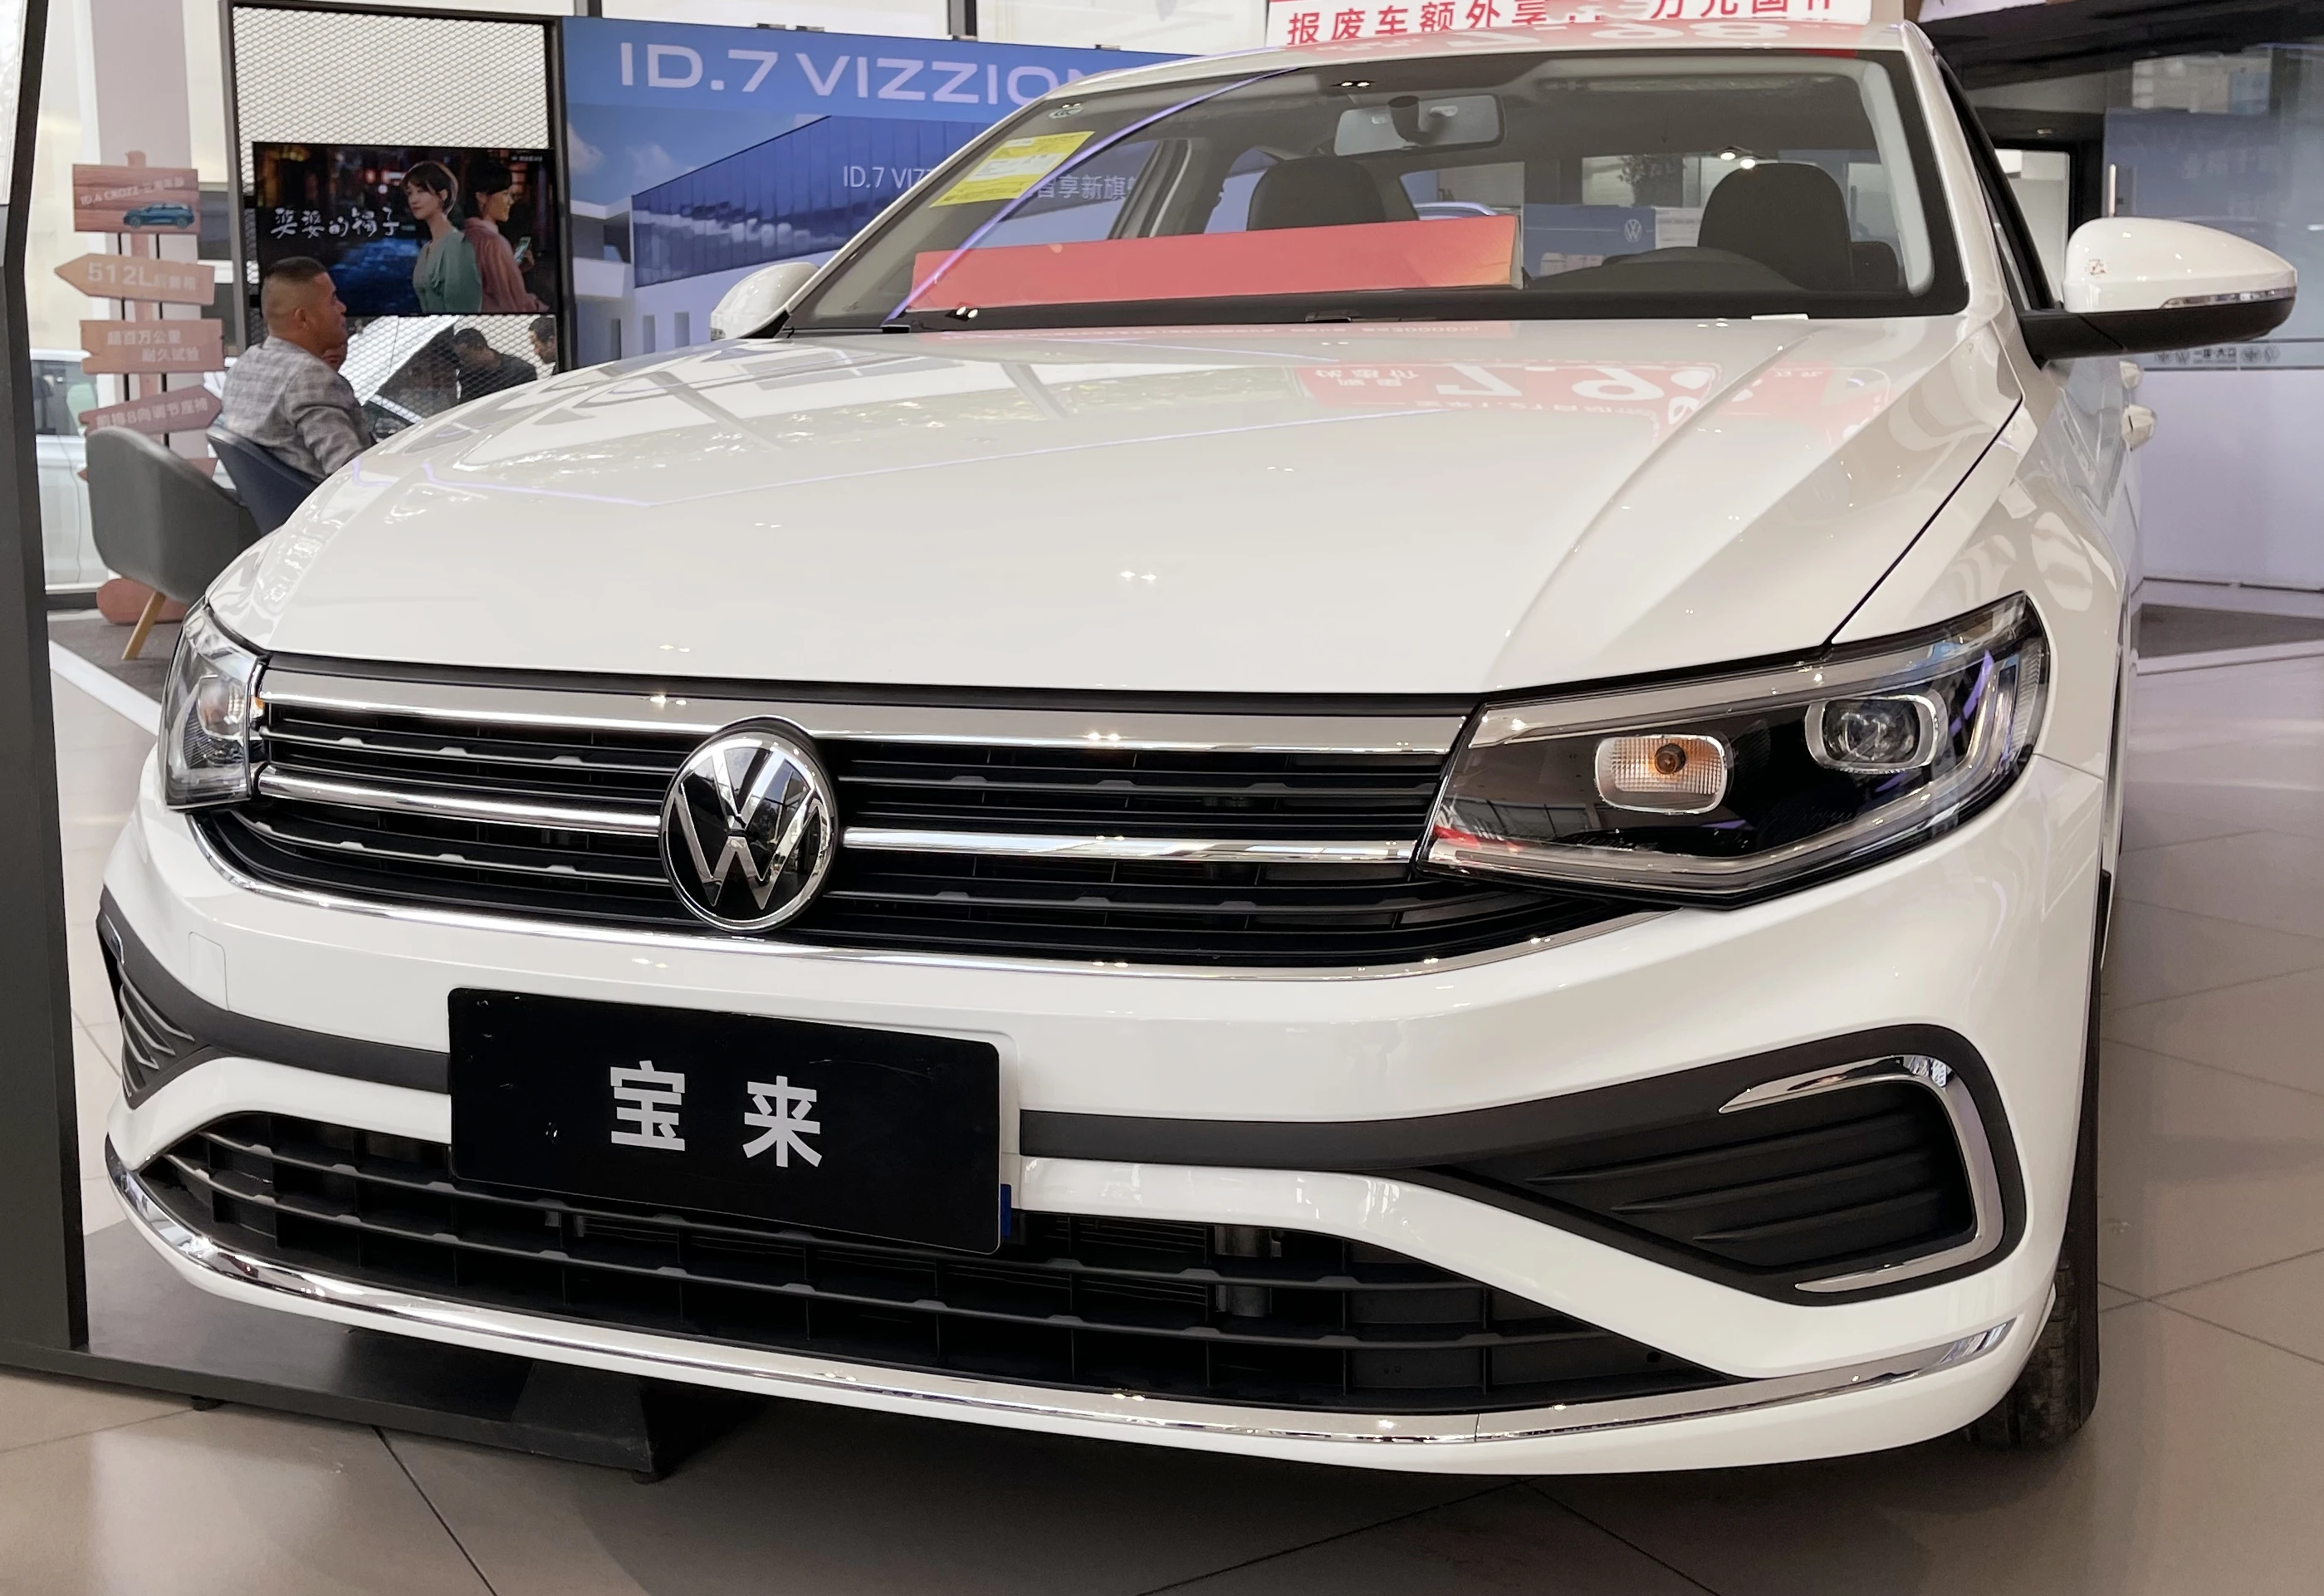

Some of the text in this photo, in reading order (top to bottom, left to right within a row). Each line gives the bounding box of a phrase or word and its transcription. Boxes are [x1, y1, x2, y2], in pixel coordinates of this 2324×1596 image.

[620, 42, 1086, 106] ID.7 VIZZIO
[843, 165, 932, 189] ID.7 VIZ
[609, 1060, 822, 1168] 宝来
